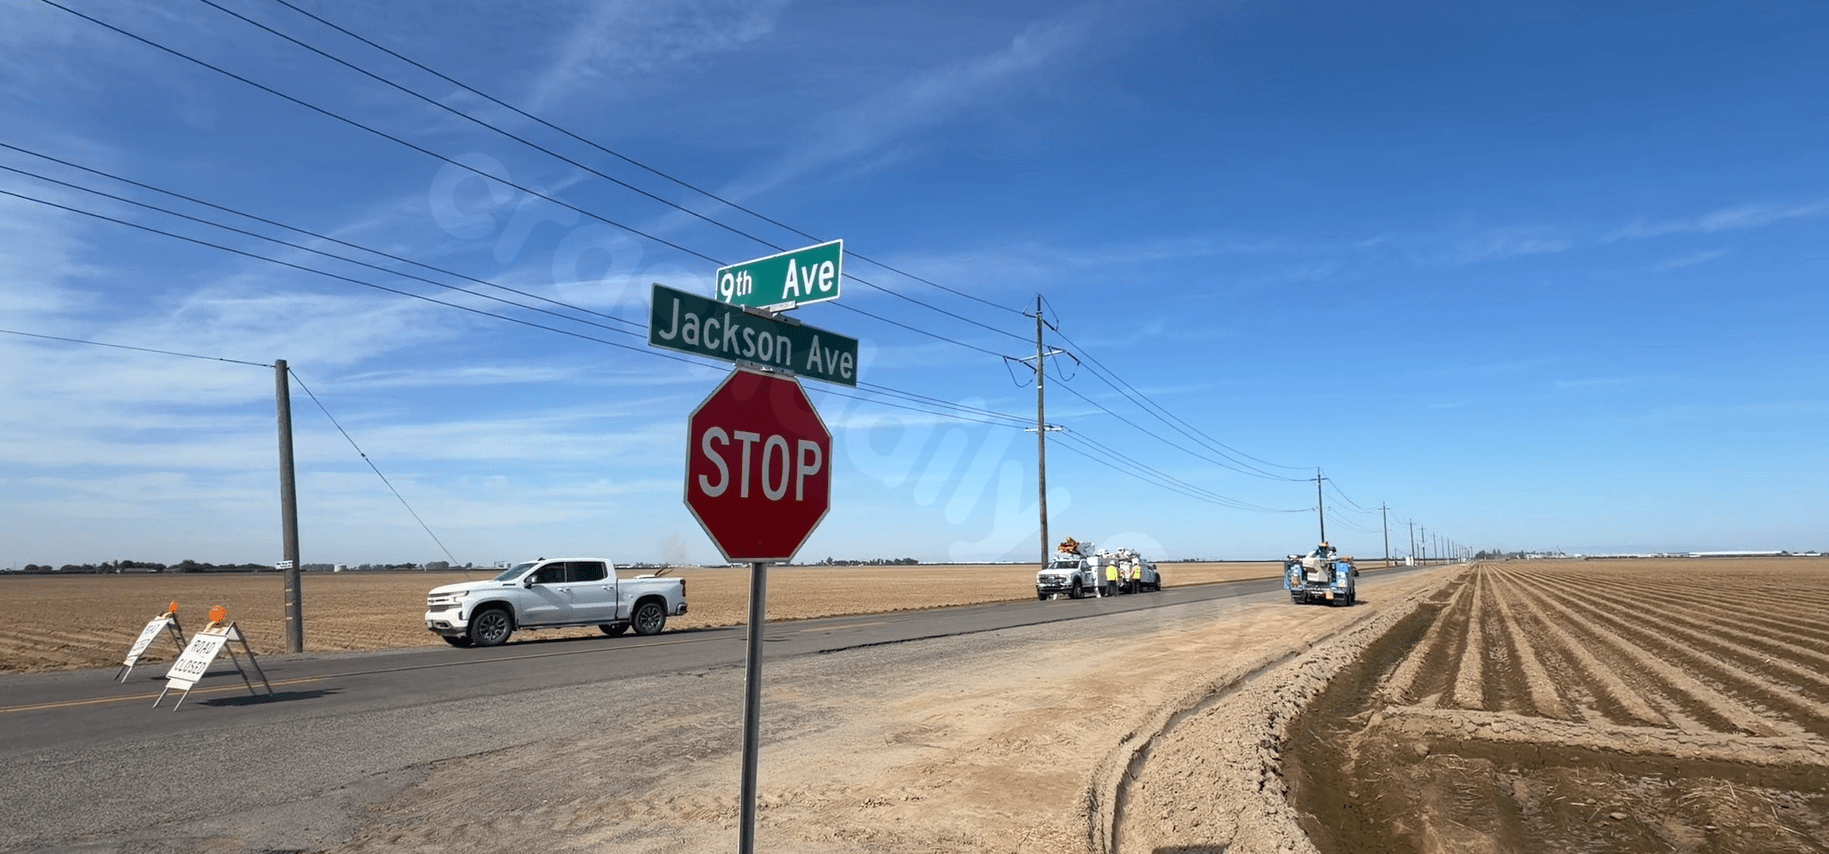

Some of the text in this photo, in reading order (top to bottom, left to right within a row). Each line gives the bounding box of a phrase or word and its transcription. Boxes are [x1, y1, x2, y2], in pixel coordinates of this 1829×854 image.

[719, 258, 835, 304] 9th Ave
[658, 298, 853, 379] Jackson Ave
[698, 426, 823, 501] STOP
[174, 658, 206, 675] CLOSED
[190, 639, 216, 655] ROAD
